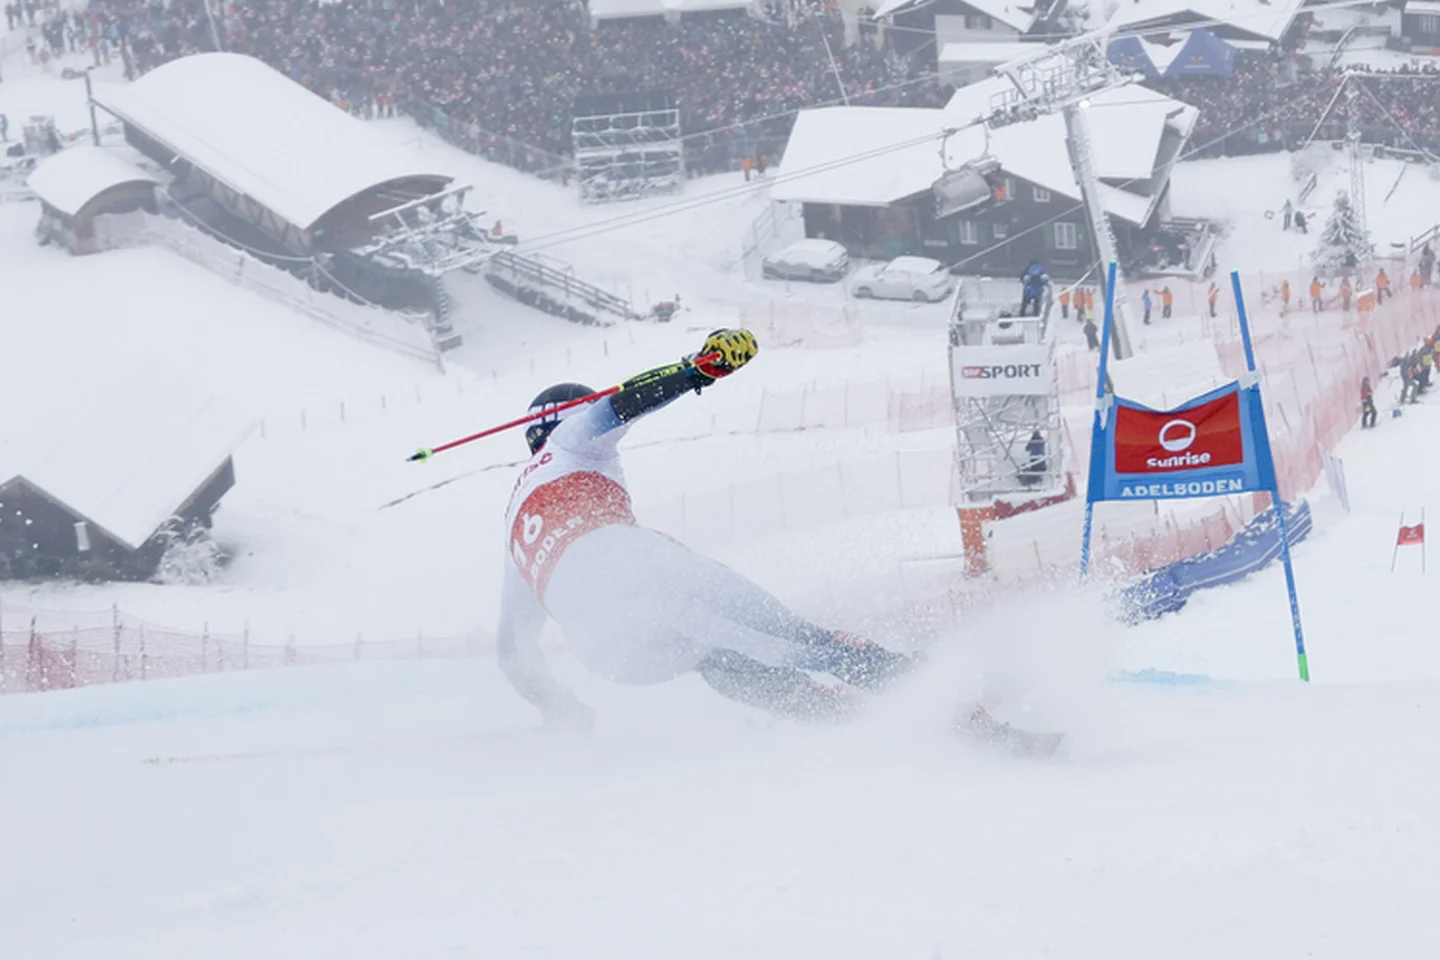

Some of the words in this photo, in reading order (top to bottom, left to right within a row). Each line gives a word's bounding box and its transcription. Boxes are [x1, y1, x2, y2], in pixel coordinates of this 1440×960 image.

[981, 363, 1041, 379] SPORT
[1146, 451, 1211, 469] Sunrise
[1121, 478, 1243, 497] ADELBODEN
